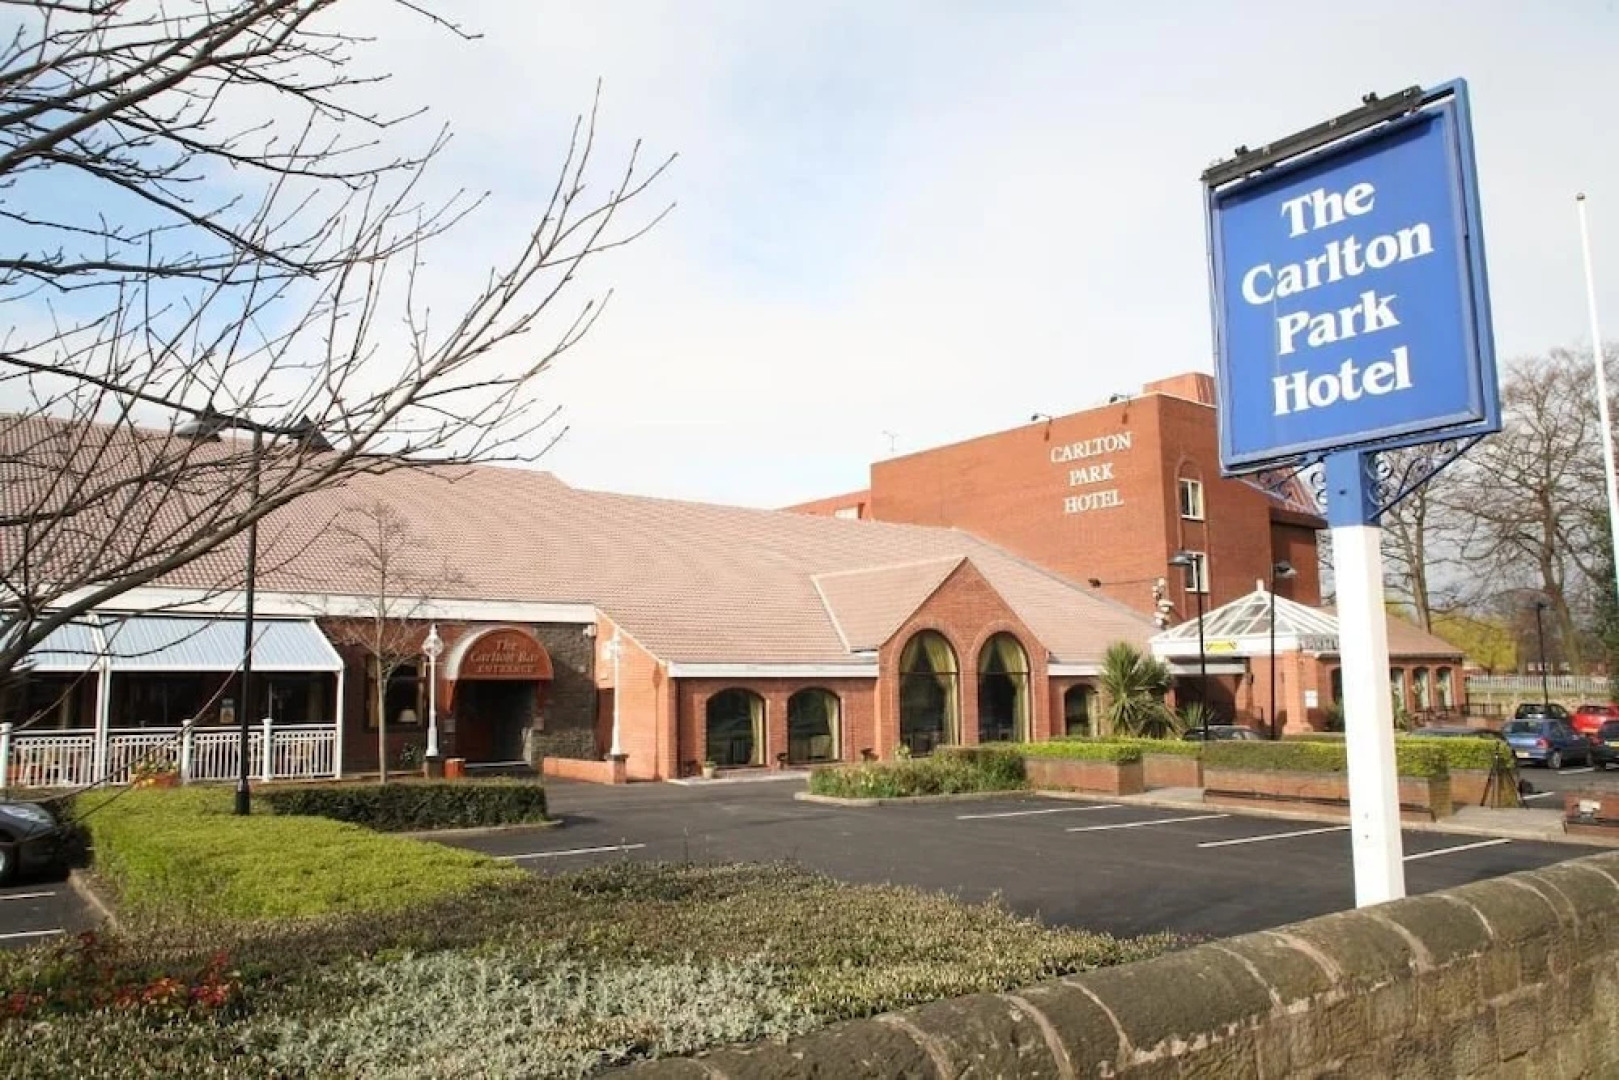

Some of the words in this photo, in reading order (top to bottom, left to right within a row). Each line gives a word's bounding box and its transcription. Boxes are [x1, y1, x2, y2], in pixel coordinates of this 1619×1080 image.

[1282, 182, 1376, 238] The
[1241, 221, 1435, 306] Carlton
[1277, 289, 1400, 356] Park
[1272, 345, 1413, 416] Hotel
[1050, 431, 1133, 463] CARLTON
[1069, 462, 1115, 487] PARK
[1063, 489, 1125, 513] HOTEL
